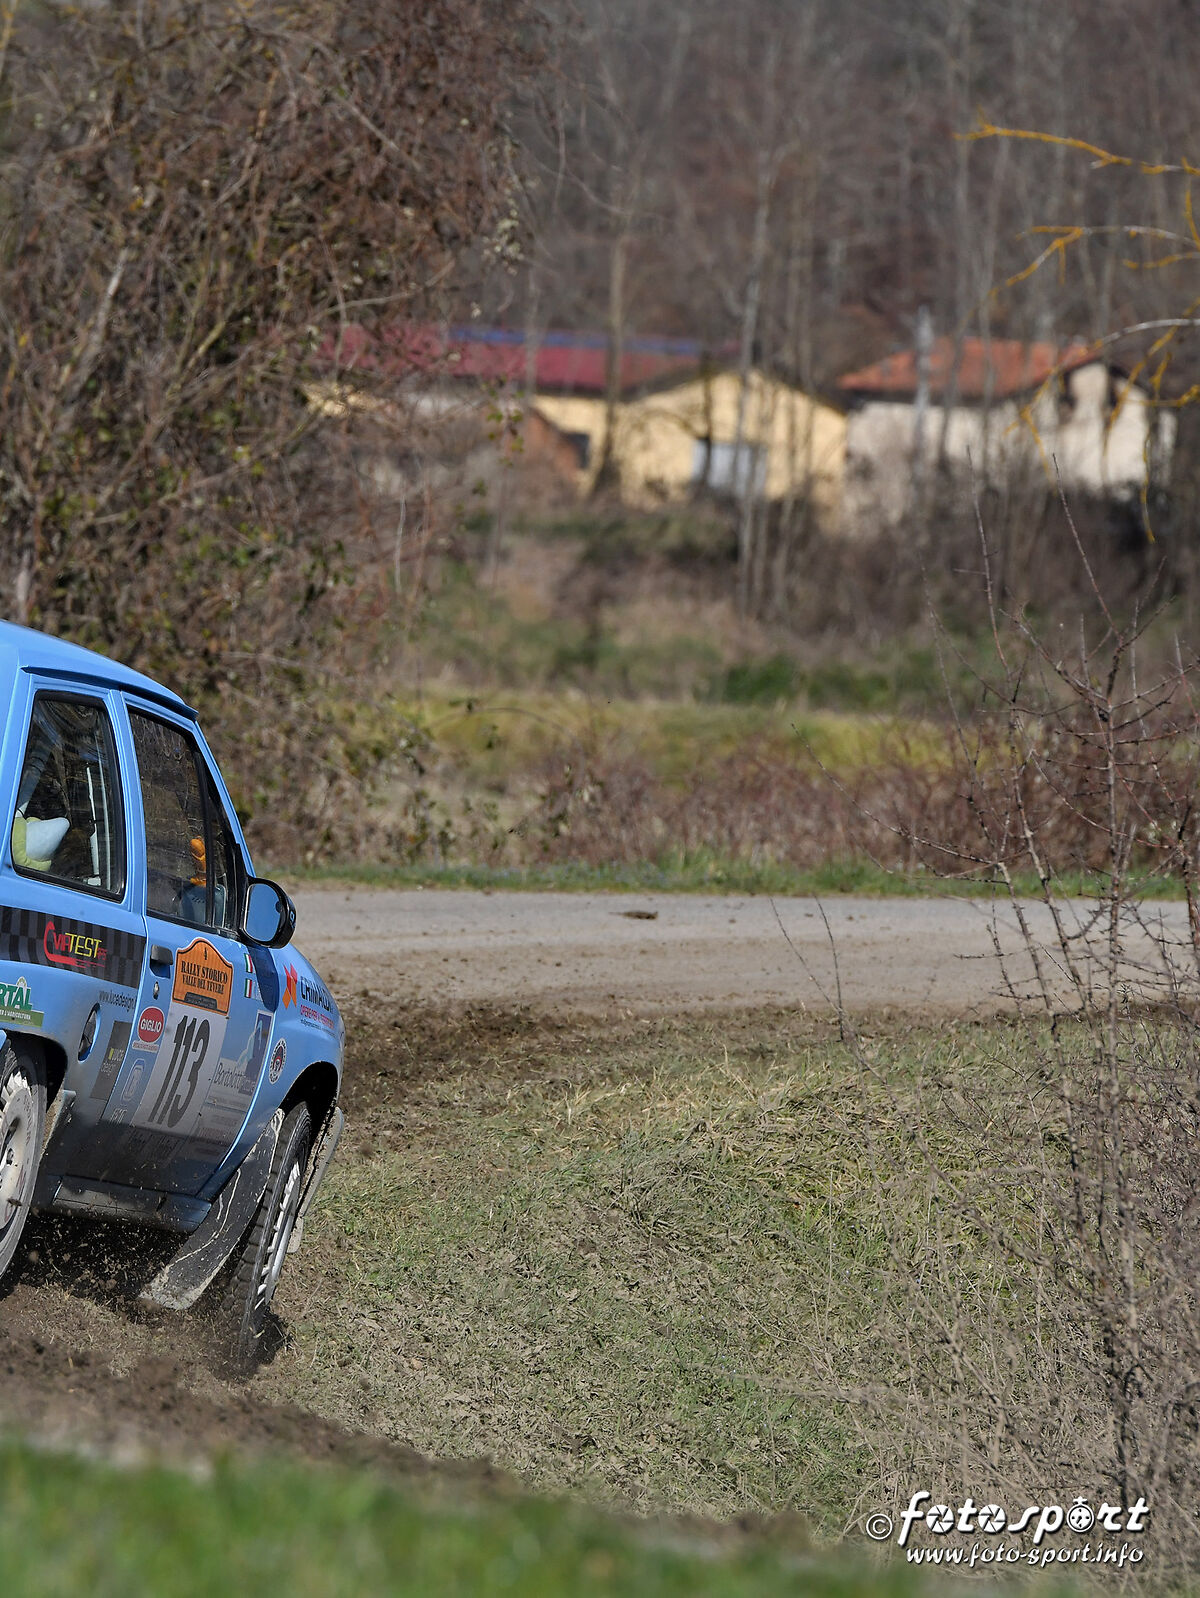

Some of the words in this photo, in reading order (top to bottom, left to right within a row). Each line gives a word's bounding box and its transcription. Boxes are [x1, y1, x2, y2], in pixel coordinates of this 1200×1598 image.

[181, 961, 201, 977] RALLY
[202, 966, 228, 984] STORICO
[182, 974, 196, 987] VALLE
[207, 981, 225, 994] TEVERE
[140, 1018, 162, 1033] GIGLIO
[147, 1015, 211, 1128] 113
